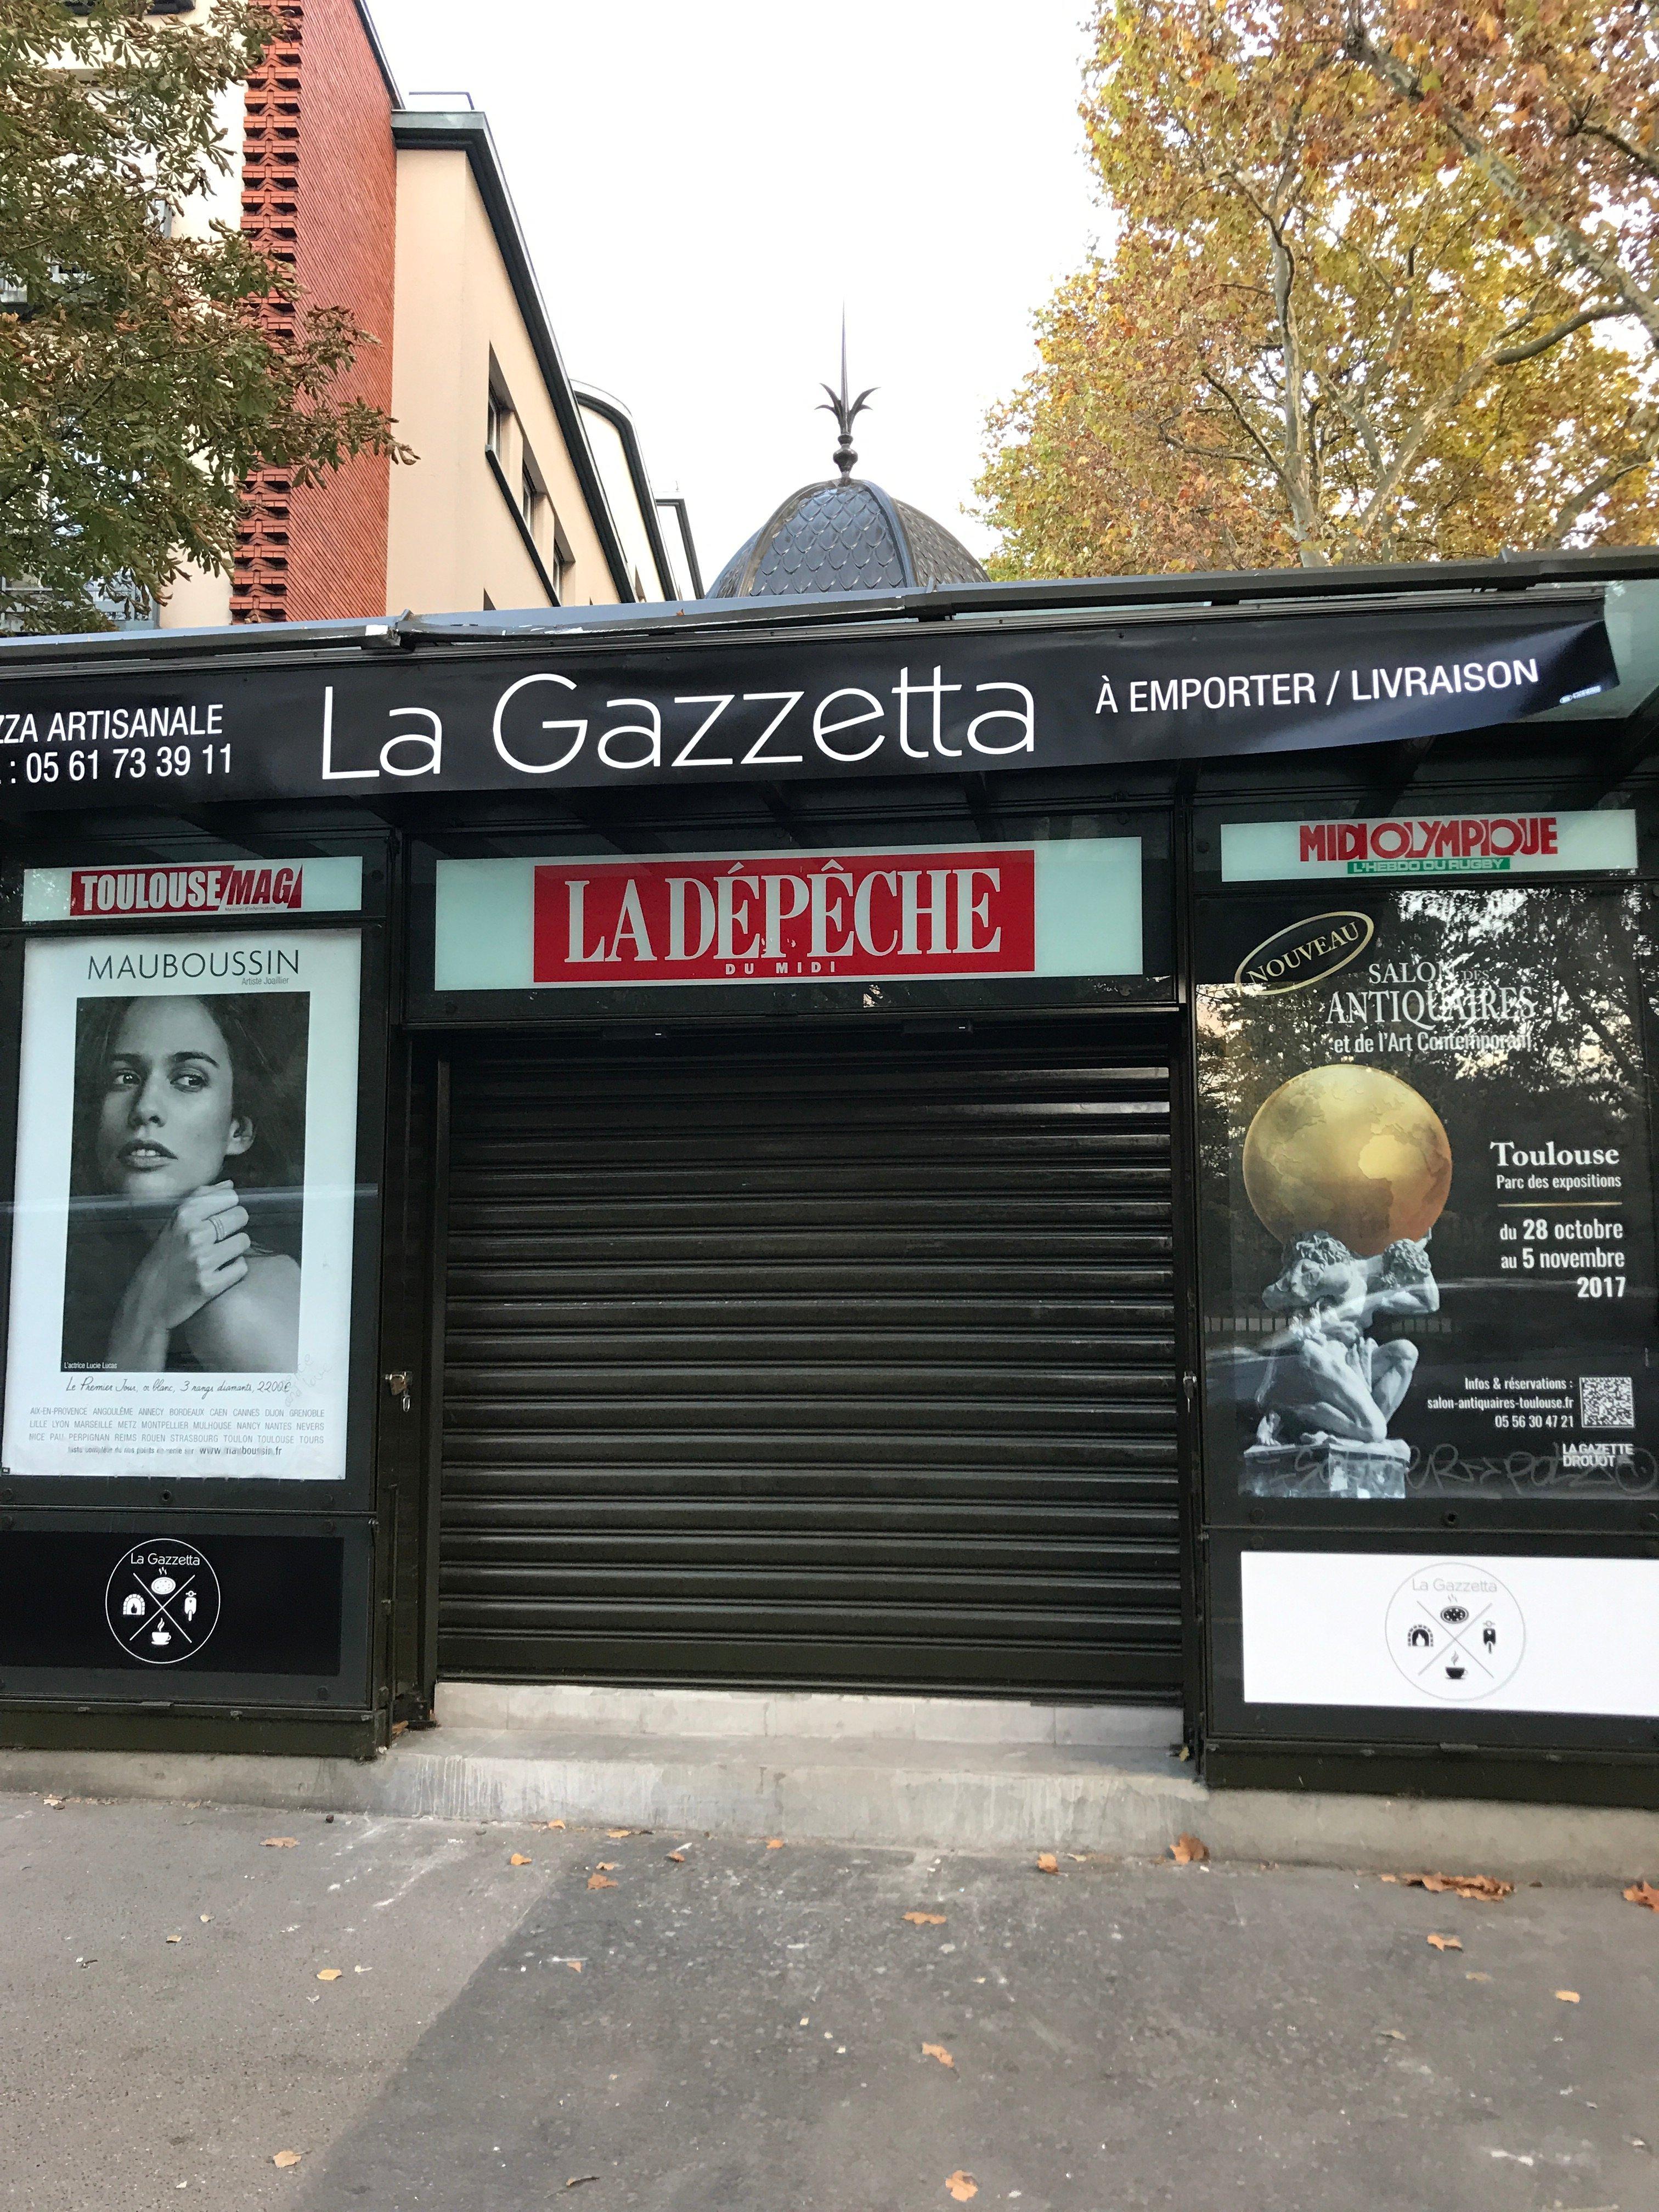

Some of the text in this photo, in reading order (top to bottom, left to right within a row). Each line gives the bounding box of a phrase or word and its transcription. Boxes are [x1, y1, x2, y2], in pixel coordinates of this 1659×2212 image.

[1095, 674, 1119, 714] À
[1130, 672, 1317, 712] EMPORTER
[1326, 670, 1340, 705] /
[1351, 658, 1539, 701] LIVRAISON
[47, 704, 223, 741] ARTISANALE
[321, 665, 1035, 780] La Gazzetta
[26, 752, 58, 783] 05
[69, 749, 98, 781] 61
[112, 747, 146, 778] 73
[156, 746, 191, 776] 39
[202, 743, 231, 774] 11
[1300, 817, 1558, 861] MIDI OLYMPIQUE
[1353, 858, 1504, 873] L'HEBDO DU RUGBY
[80, 867, 294, 911] TOULOUSE MAG
[565, 859, 1001, 963] LA DÉPÊCHE
[1246, 922, 1359, 984] NOUVEAU
[88, 950, 299, 980] MAUBOUSSIN
[725, 961, 836, 975] DU MIDI
[1368, 961, 1489, 984] SALON DES
[241, 977, 289, 985] Artiste Joaillier
[1325, 986, 1537, 1030] ANTIQUAIRES
[1334, 1035, 1351, 1053] et
[1355, 1034, 1374, 1053] de
[1378, 1031, 1413, 1052] l'Art
[1489, 1141, 1620, 1166] Toulouse
[1496, 1173, 1622, 1190] Parc des expositions
[1499, 1218, 1623, 1240] du 28 octobre
[1500, 1247, 1625, 1268] au 5 novembre
[1577, 1276, 1626, 1298] 2017
[66, 1376, 76, 1391] Le
[81, 1376, 113, 1391] Premier
[115, 1379, 138, 1393] Jour,
[152, 1379, 176, 1393] blanc,
[180, 1380, 190, 1391] 3
[191, 1385, 214, 1400] rangs
[217, 1380, 255, 1393] diamants,
[257, 1381, 291, 1392] 2200€
[1465, 1377, 1490, 1390] Infos
[1493, 1377, 1502, 1390] &
[1504, 1376, 1567, 1390] réservations
[30, 1407, 325, 1417] AIX-EN-PROVENCE ANGOULÊME ANNECY BORDEAUX CAEN CANNES DIJON GRENOBLE
[1427, 1395, 1574, 1410] salon-antiquaires-toulouse.fr
[29, 1420, 325, 1430] LILLE LYON MARSEILLE METZ MONTPELLIER MULHOUSE NANCY NANTES NEVERS
[1494, 1415, 1575, 1427] 05 56 30 47 21
[69, 1433, 110, 1441] PERPIGNAN
[114, 1433, 137, 1441] REIMS
[142, 1434, 166, 1442] ROUEN
[170, 1434, 218, 1443] STRASBOURG
[223, 1435, 253, 1443] TOULON
[257, 1435, 294, 1443] TOULOUSE
[300, 1435, 324, 1444] TOURS
[1562, 1443, 1635, 1454] LA GAZETTE
[1562, 1455, 1616, 1467] DROUOT
[131, 1553, 200, 1565] La Gazzetta
[1412, 1578, 1497, 1592] La Gazzetta
